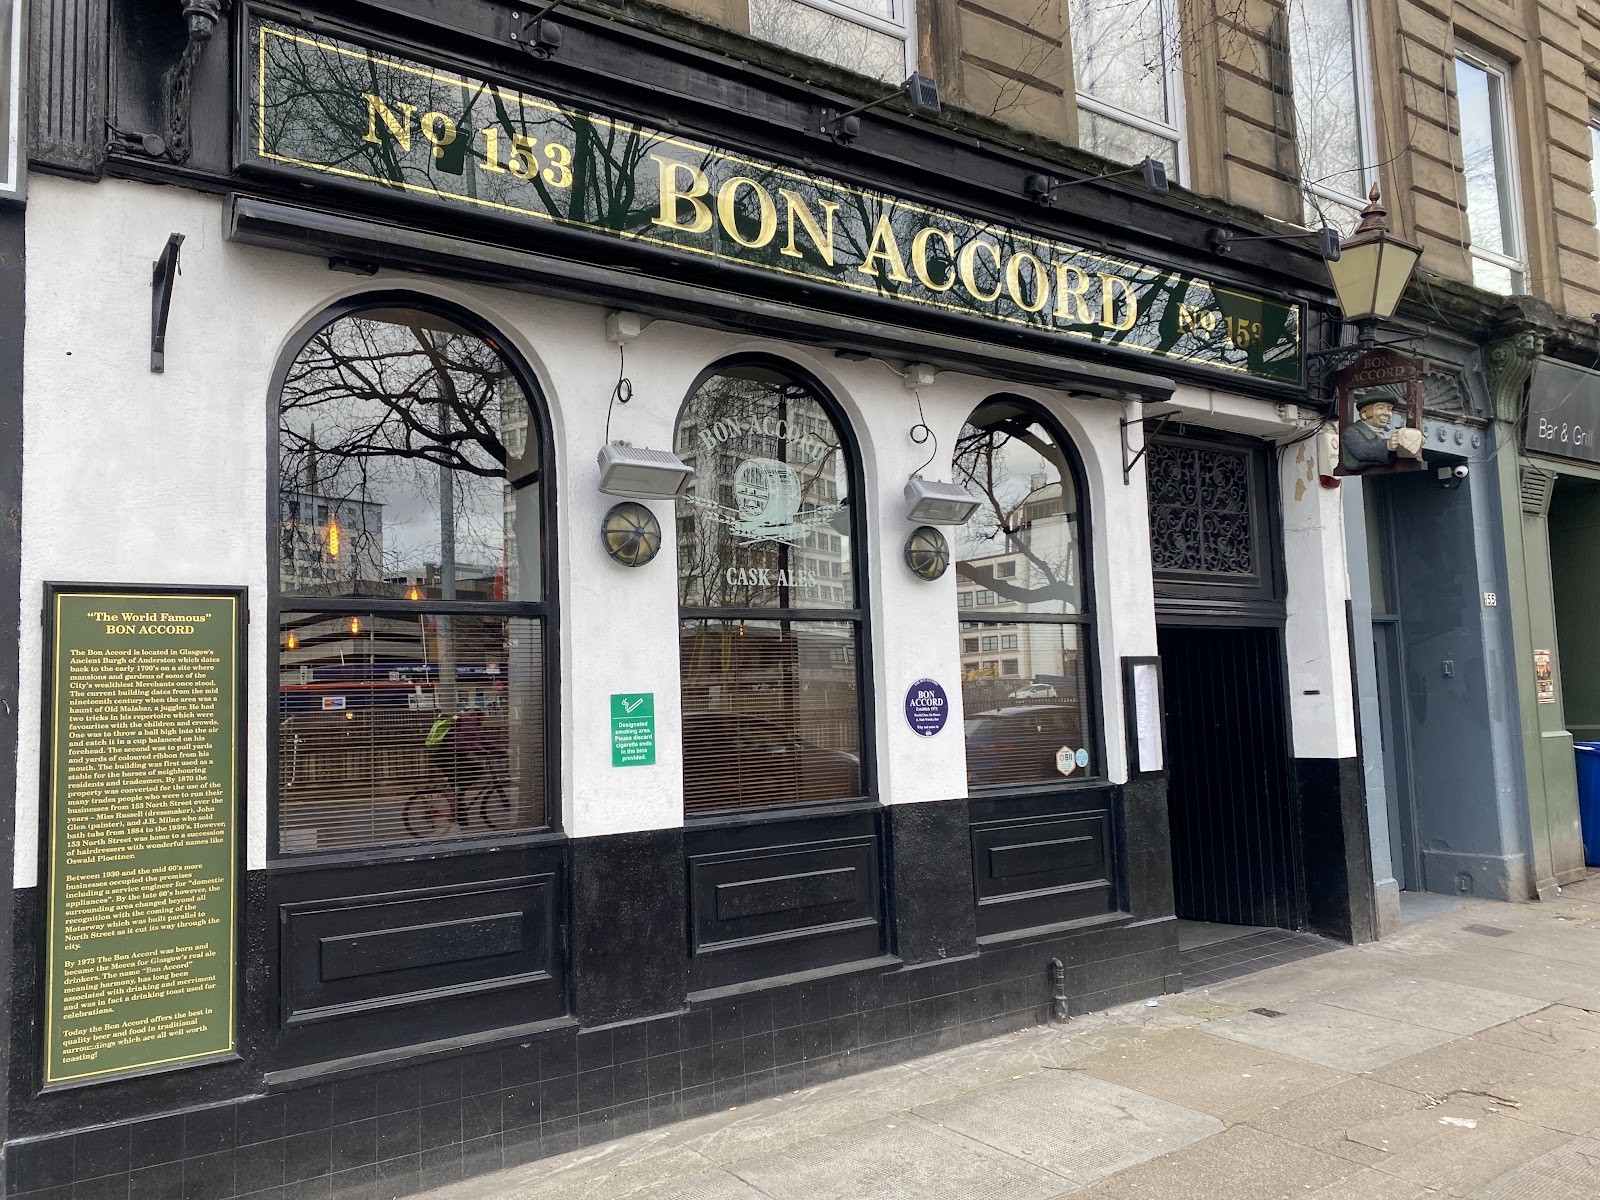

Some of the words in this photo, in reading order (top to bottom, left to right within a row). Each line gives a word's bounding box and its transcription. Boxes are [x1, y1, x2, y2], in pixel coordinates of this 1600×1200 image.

[480, 128, 573, 188] 153
[650, 154, 840, 267] BON
[859, 214, 1138, 331] ACCORD
[1364, 356, 1392, 369] BON
[1352, 366, 1404, 382] ACCORD
[699, 416, 742, 450] BON
[750, 416, 826, 462] ACCORD
[1538, 418, 1558, 440] Bar
[1560, 422, 1568, 442] &
[1572, 426, 1594, 448] Grill
[726, 568, 770, 586] CASK
[776, 570, 818, 587] ALES
[87, 612, 117, 620] “The
[121, 612, 156, 621] World
[160, 613, 211, 621] Famous”
[106, 625, 135, 633] BON
[138, 625, 194, 634] ACCORD
[910, 698, 943, 706] ACCORD
[66, 856, 94, 864] Oswald
[109, 876, 142, 885] occupied
[159, 872, 191, 881] premises
[66, 890, 103, 898] including
[65, 905, 114, 915] surrounding
[135, 898, 166, 907] changed
[168, 895, 194, 904] beyond
[131, 949, 157, 958] Accord
[64, 990, 104, 1001] associated
[126, 983, 159, 992] drinking
[177, 974, 215, 984] merriment
[121, 1017, 148, 1027] Accord
[62, 1051, 97, 1062] toasting!
